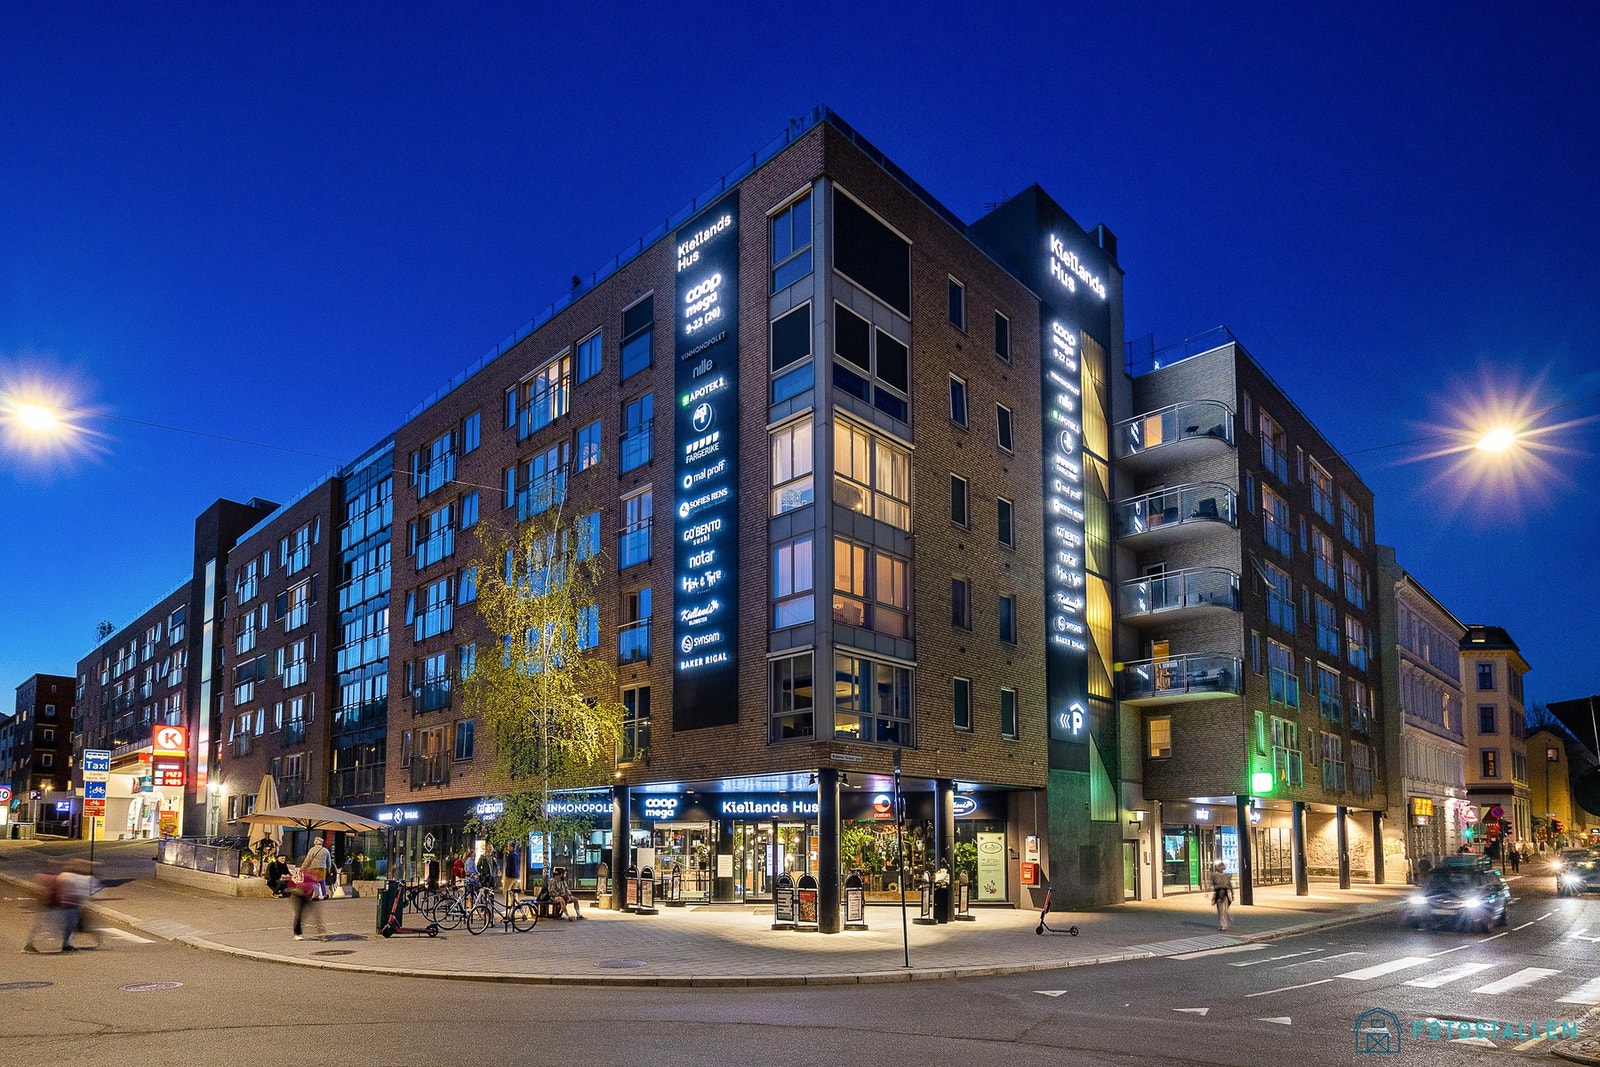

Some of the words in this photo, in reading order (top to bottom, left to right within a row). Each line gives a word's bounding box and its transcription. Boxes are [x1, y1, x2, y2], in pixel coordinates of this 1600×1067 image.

[678, 215, 731, 258] Kiellands
[678, 250, 699, 272] Hus
[1051, 234, 1106, 299] Kiellands
[1051, 256, 1076, 293] Hus
[686, 273, 722, 303] coop
[686, 291, 718, 318] mega
[686, 316, 704, 334] 9-22
[680, 330, 726, 360] VINMONOPOLET
[692, 358, 713, 378] nille
[690, 380, 718, 402] APOTEK
[686, 442, 720, 464] FARGERIKE
[694, 468, 706, 482] mal
[690, 494, 710, 509] SOFIES
[710, 488, 728, 500] RENS
[692, 534, 710, 546] sushi
[690, 550, 715, 568] notar
[680, 656, 704, 670] BAKER
[704, 652, 727, 665] RIGAL
[164, 732, 180, 747] K
[86, 760, 108, 770] Taxi
[547, 804, 614, 813] INMONOPOLE
[645, 798, 678, 809] coop
[722, 801, 788, 814] Kiellands
[792, 800, 818, 813] Hus
[645, 809, 674, 819] mega
